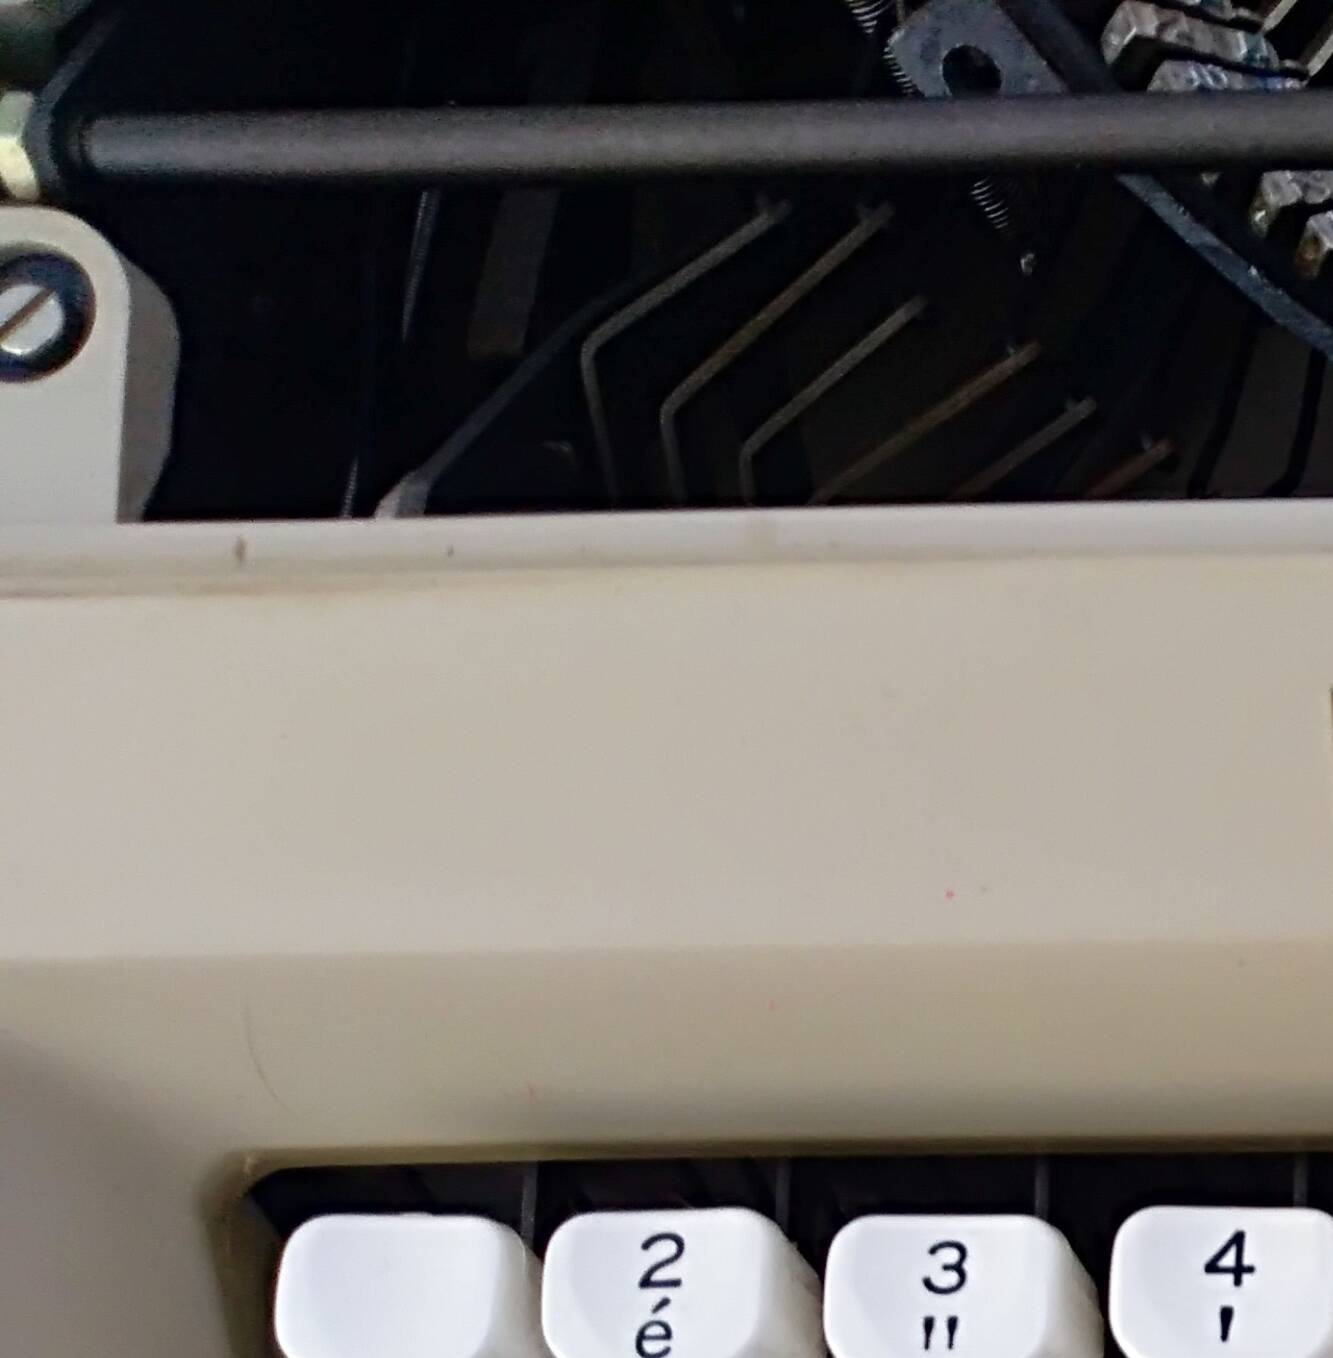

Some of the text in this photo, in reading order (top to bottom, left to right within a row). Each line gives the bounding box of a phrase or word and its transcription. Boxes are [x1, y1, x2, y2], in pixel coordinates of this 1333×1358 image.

[639, 1233, 684, 1289] 2
[923, 1241, 967, 1295] 3
[1204, 1231, 1255, 1287] 4
